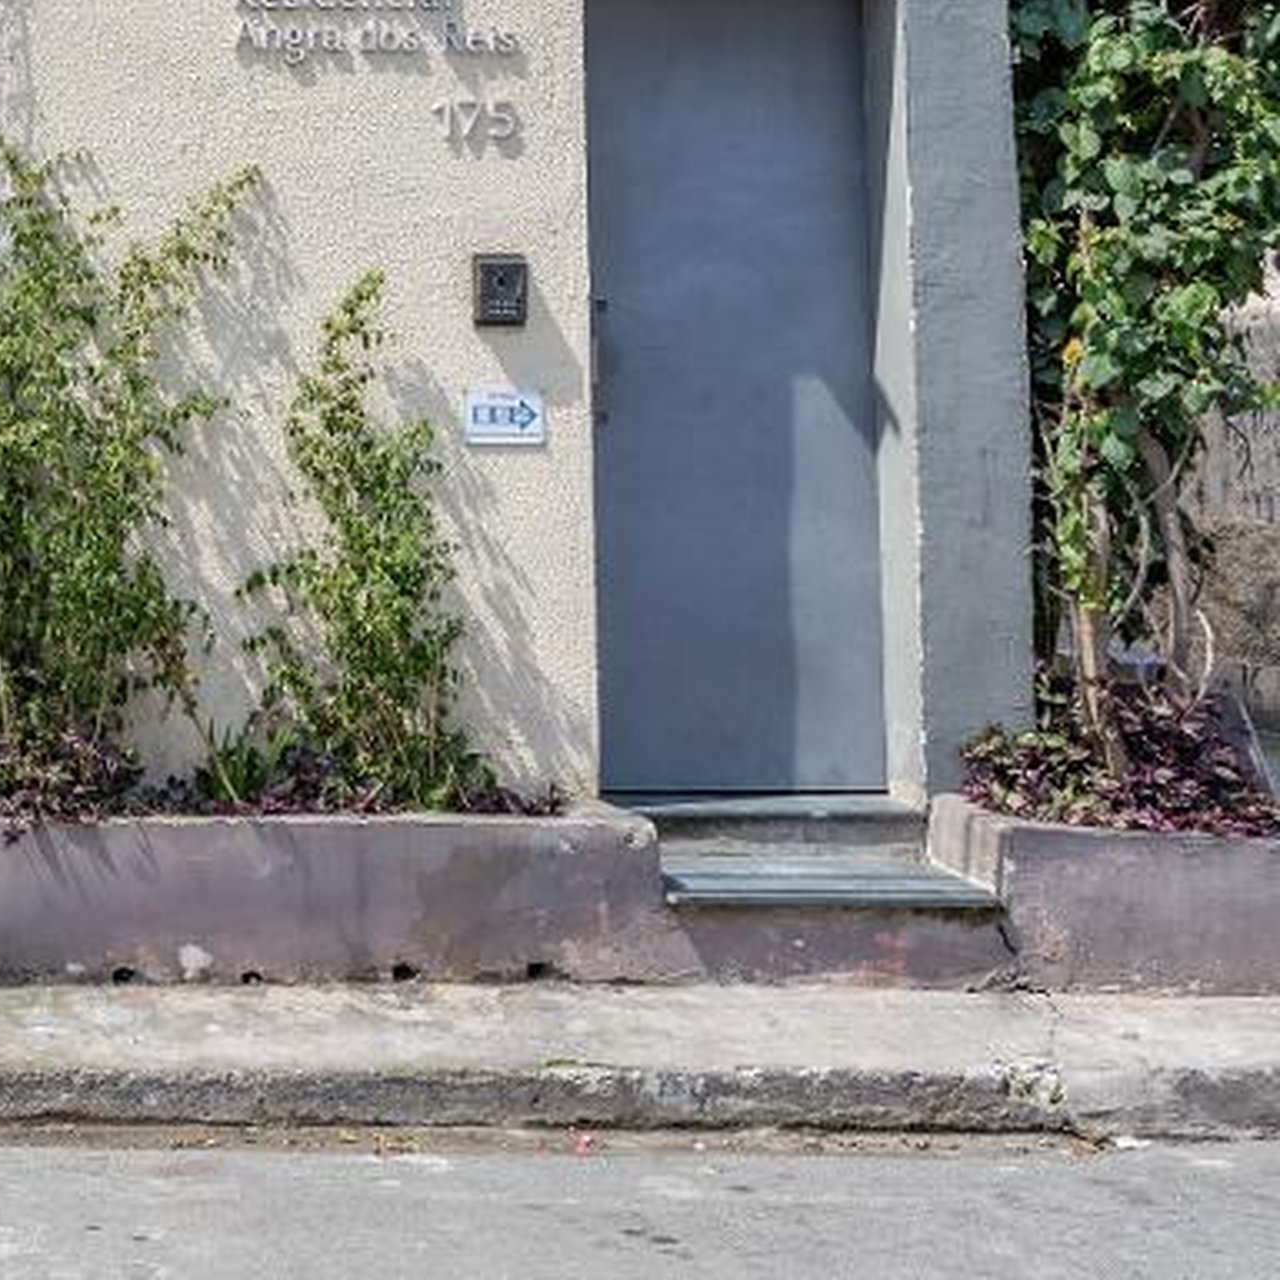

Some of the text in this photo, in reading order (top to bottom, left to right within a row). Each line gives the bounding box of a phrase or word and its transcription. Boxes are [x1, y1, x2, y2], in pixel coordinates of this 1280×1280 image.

[235, 18, 519, 65] Angra dos Reis
[431, 101, 518, 140] 175
